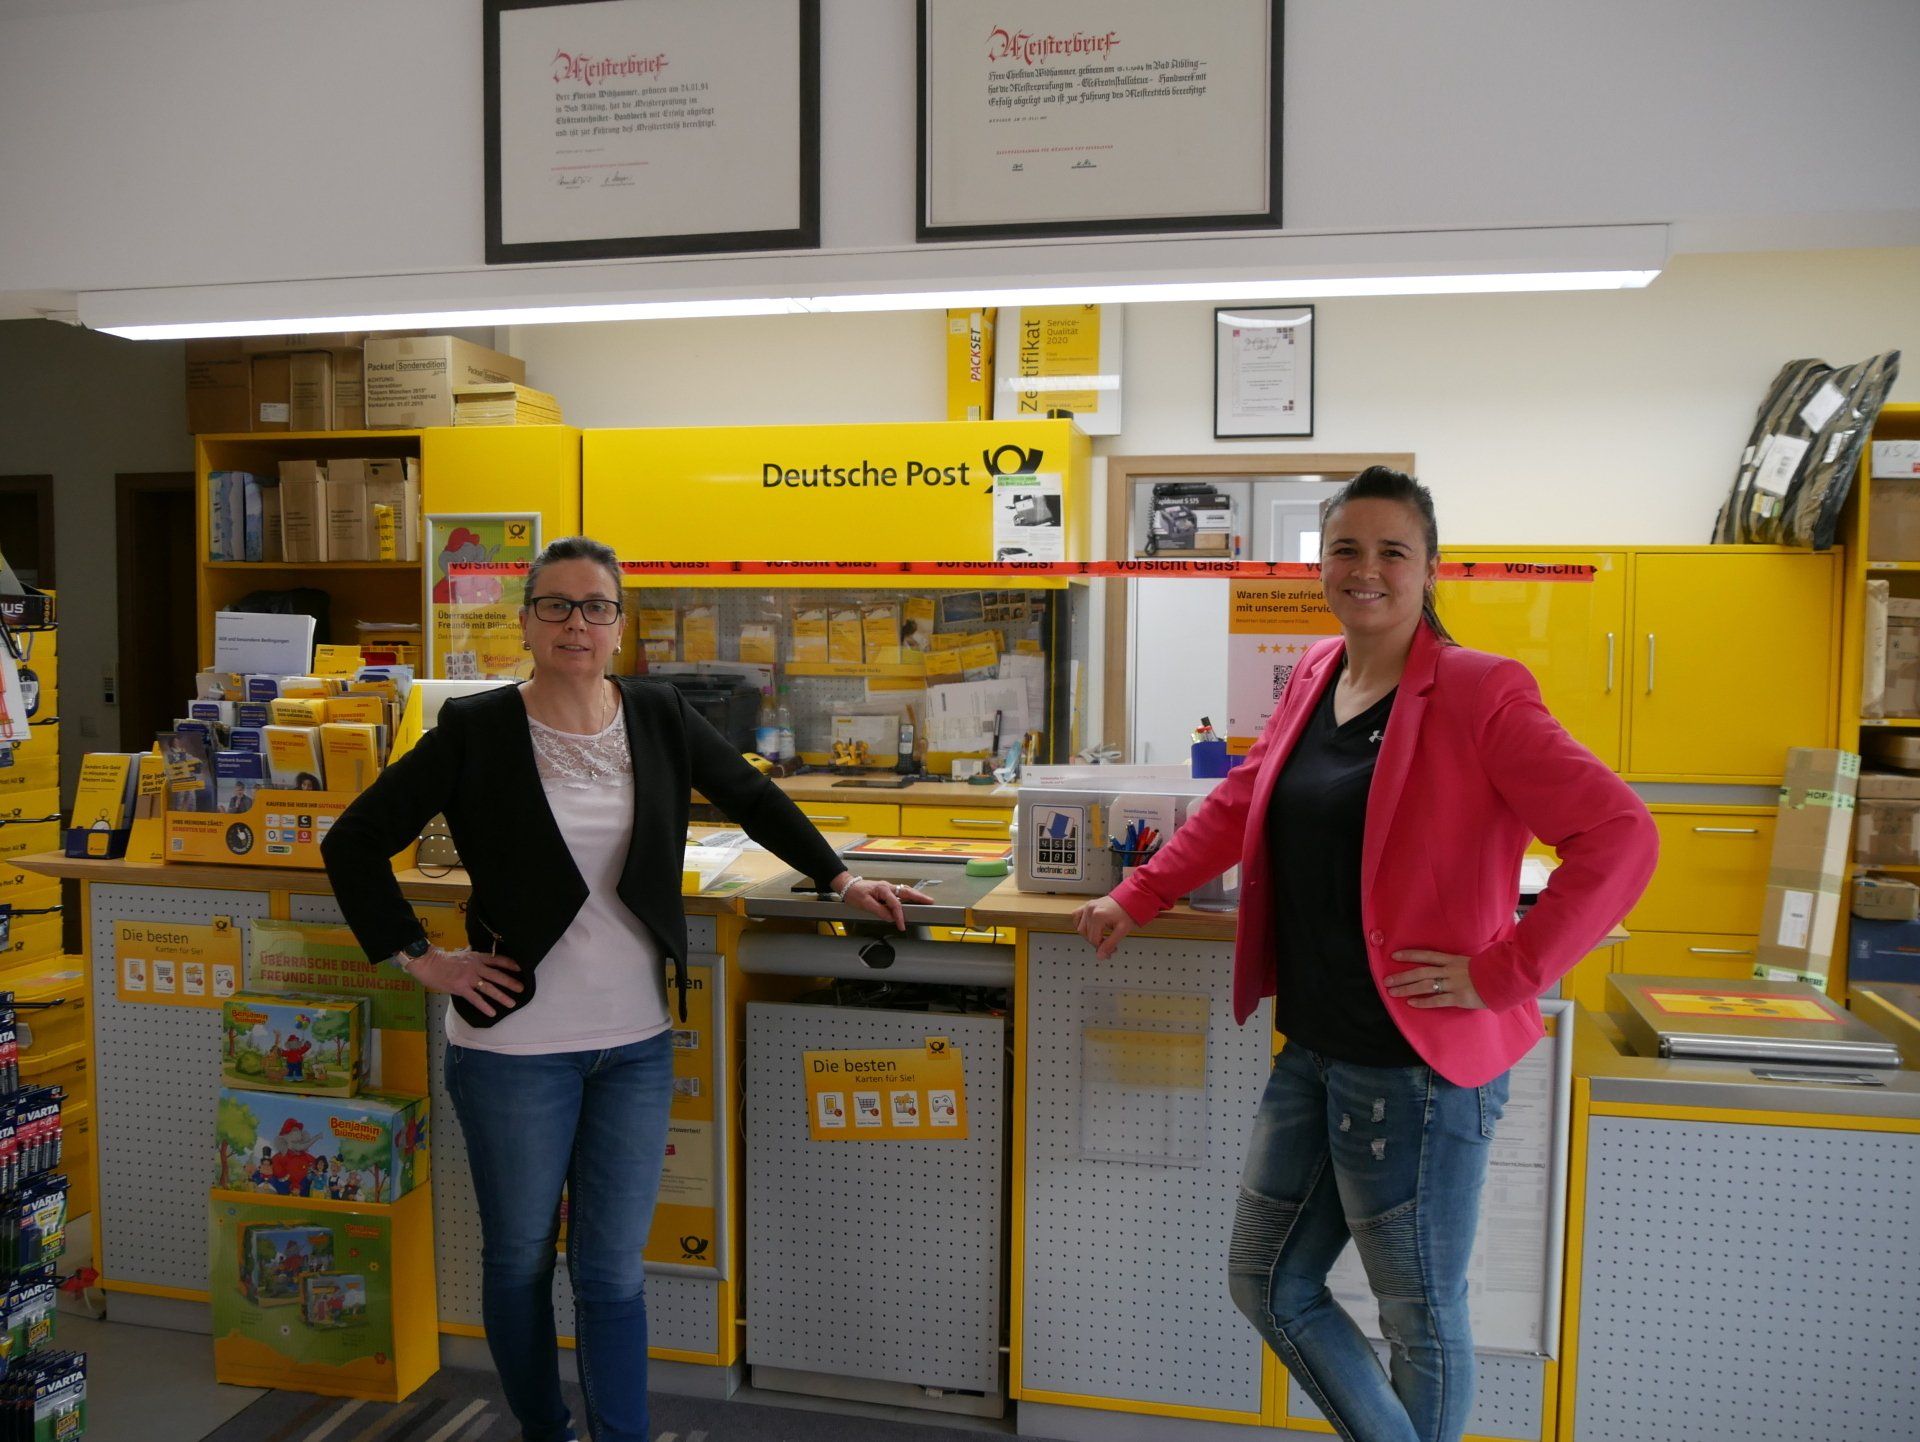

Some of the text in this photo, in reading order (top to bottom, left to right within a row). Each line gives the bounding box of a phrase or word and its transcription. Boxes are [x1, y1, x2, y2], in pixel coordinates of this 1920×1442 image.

[987, 25, 1120, 65] Meisterbrief
[550, 49, 668, 86] Meisterbrief
[989, 72, 1005, 81] Herr
[1006, 69, 1034, 80] Christian
[1104, 66, 1115, 74] am
[1153, 60, 1169, 71] Bad
[999, 84, 1009, 93] die
[1195, 73, 1207, 81] mit
[988, 97, 1012, 108] Erfolg
[1014, 96, 1041, 108] abgelegt
[1043, 95, 1056, 103] und
[1057, 94, 1065, 104] ist
[1066, 95, 1078, 104] zur
[1113, 91, 1124, 99] des
[1047, 328, 1079, 336] Qualität
[1047, 337, 1068, 345] 2020
[970, 328, 982, 382] PACKSET
[398, 360, 446, 371] Sonderedition
[1021, 320, 1041, 412] Zetifikat
[762, 460, 970, 488] Deutsche Post
[622, 561, 666, 569] rsicht
[1236, 590, 1324, 602] Waren Sie zufried
[438, 611, 506, 620] Überrasche deine
[1236, 604, 1331, 613] mit unserem Servic
[487, 621, 523, 629] Blümche
[1054, 841, 1061, 849] 5
[1066, 841, 1073, 849] 6
[1054, 854, 1061, 862] 8
[1066, 854, 1072, 862] 9
[1037, 866, 1063, 875] electronic
[122, 929, 189, 944] Die besten
[155, 946, 178, 954] Karten
[260, 951, 378, 973] ÜBERRASCHE DEINE
[260, 970, 416, 992] FREUNDE MIT BLÜMCHEN!
[813, 1058, 897, 1073] Die besten
[855, 1074, 915, 1083] Karten für Sie!
[27, 1104, 60, 1122] VARTA
[330, 1117, 381, 1136] Benjamin
[31, 1191, 65, 1211] VARTA
[47, 1371, 84, 1393] VARTA
